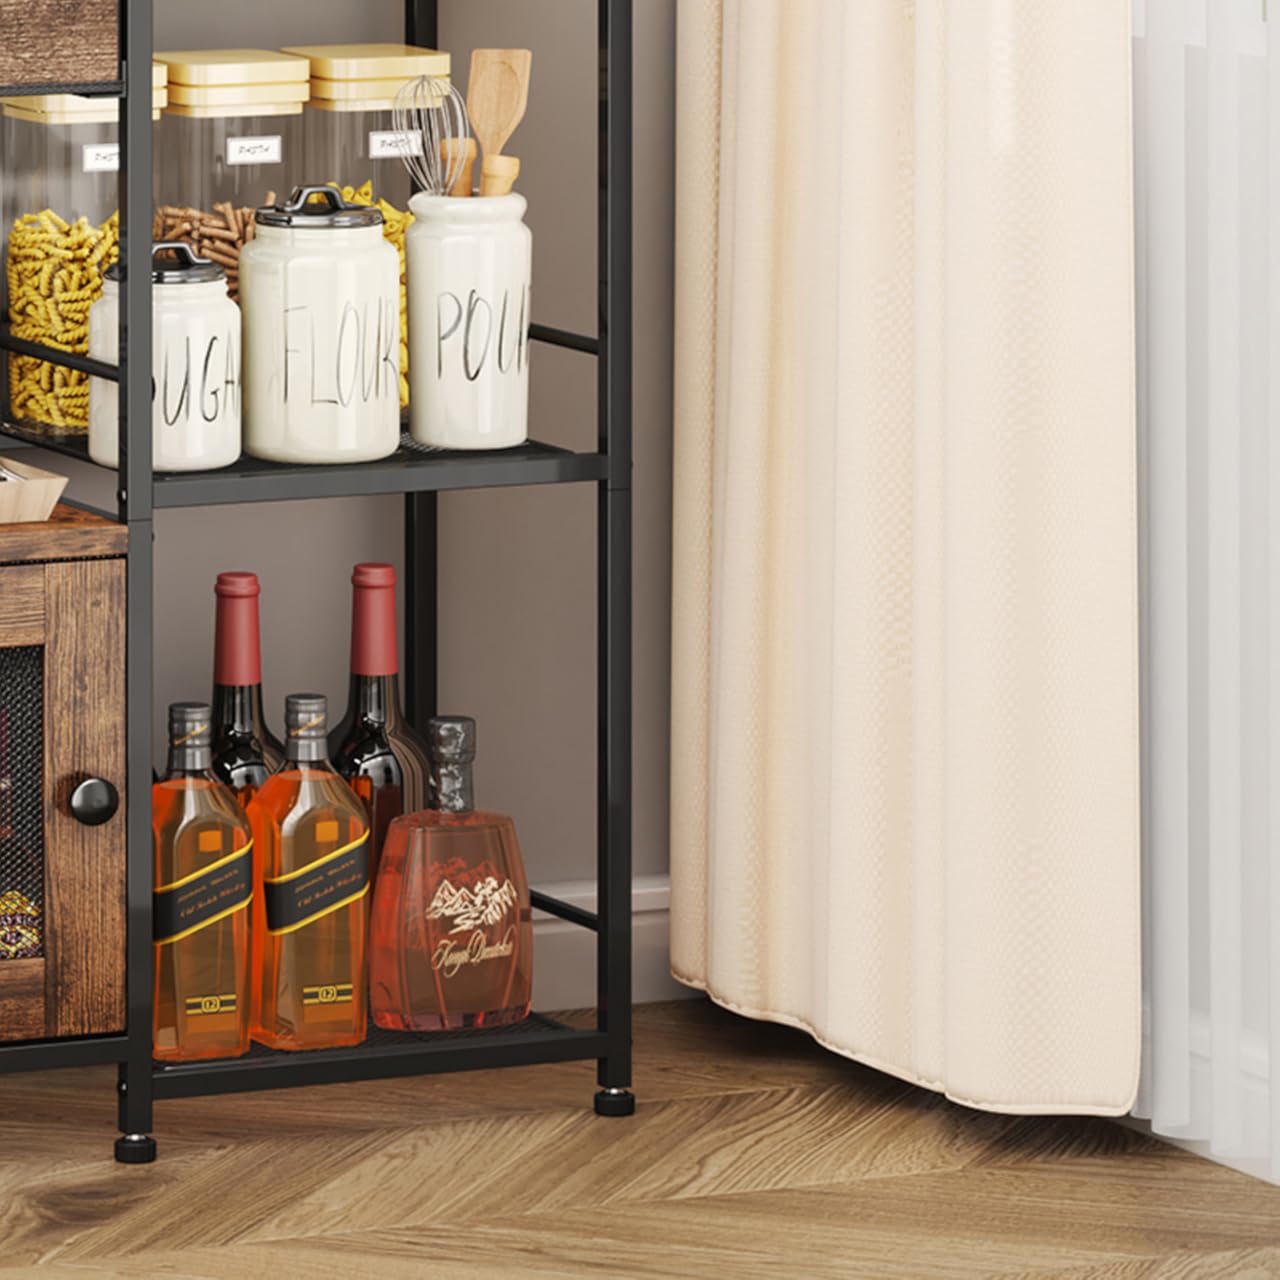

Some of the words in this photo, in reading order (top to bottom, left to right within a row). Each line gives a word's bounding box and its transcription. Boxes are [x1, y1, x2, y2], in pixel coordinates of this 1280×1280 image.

[151, 328, 241, 426] UGA
[282, 294, 401, 408] FLOUR
[436, 283, 528, 381] POU
